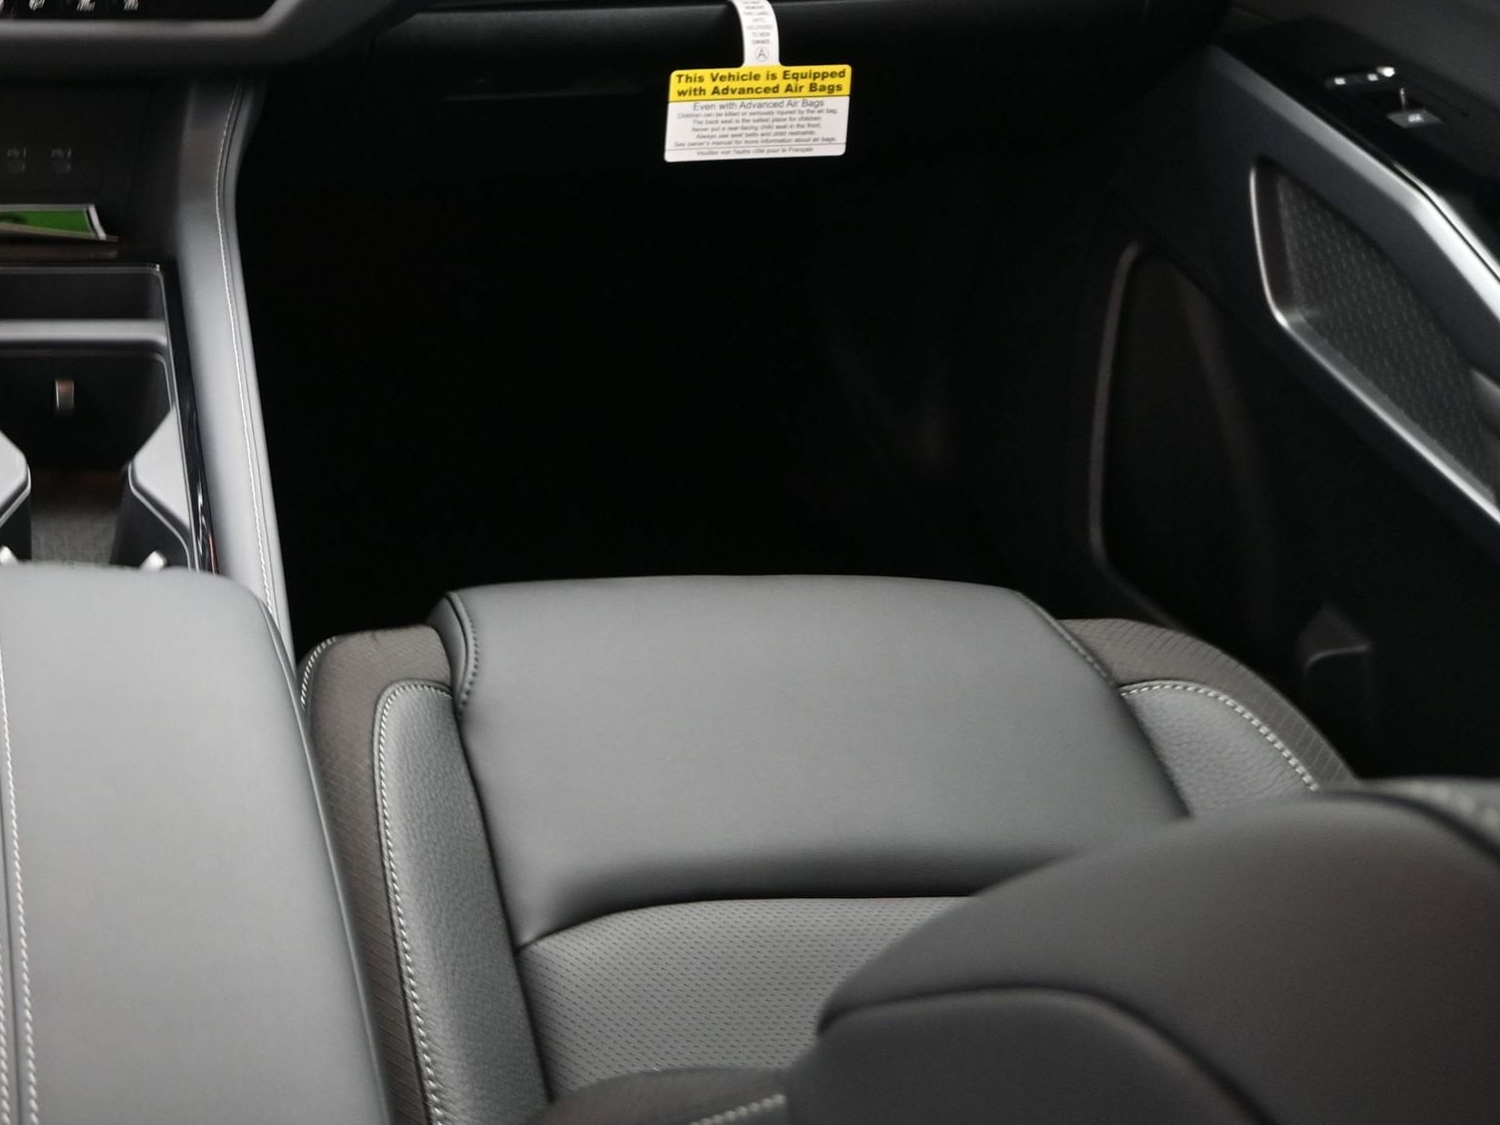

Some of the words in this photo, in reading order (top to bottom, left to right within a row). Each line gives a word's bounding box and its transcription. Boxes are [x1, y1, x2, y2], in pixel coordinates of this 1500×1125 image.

[756, 49, 766, 58] A
[676, 74, 705, 83] This
[710, 71, 761, 83] Vehicle
[766, 71, 777, 81] is
[783, 68, 846, 81] Equipped
[677, 87, 706, 97] with
[711, 84, 780, 95] Advanced
[784, 83, 804, 93] Air
[809, 82, 843, 93] Bags
[693, 102, 716, 111] Even
[719, 101, 737, 110] with
[740, 100, 784, 109] Advanced
[786, 99, 799, 107] Air
[802, 99, 824, 109] Bags
